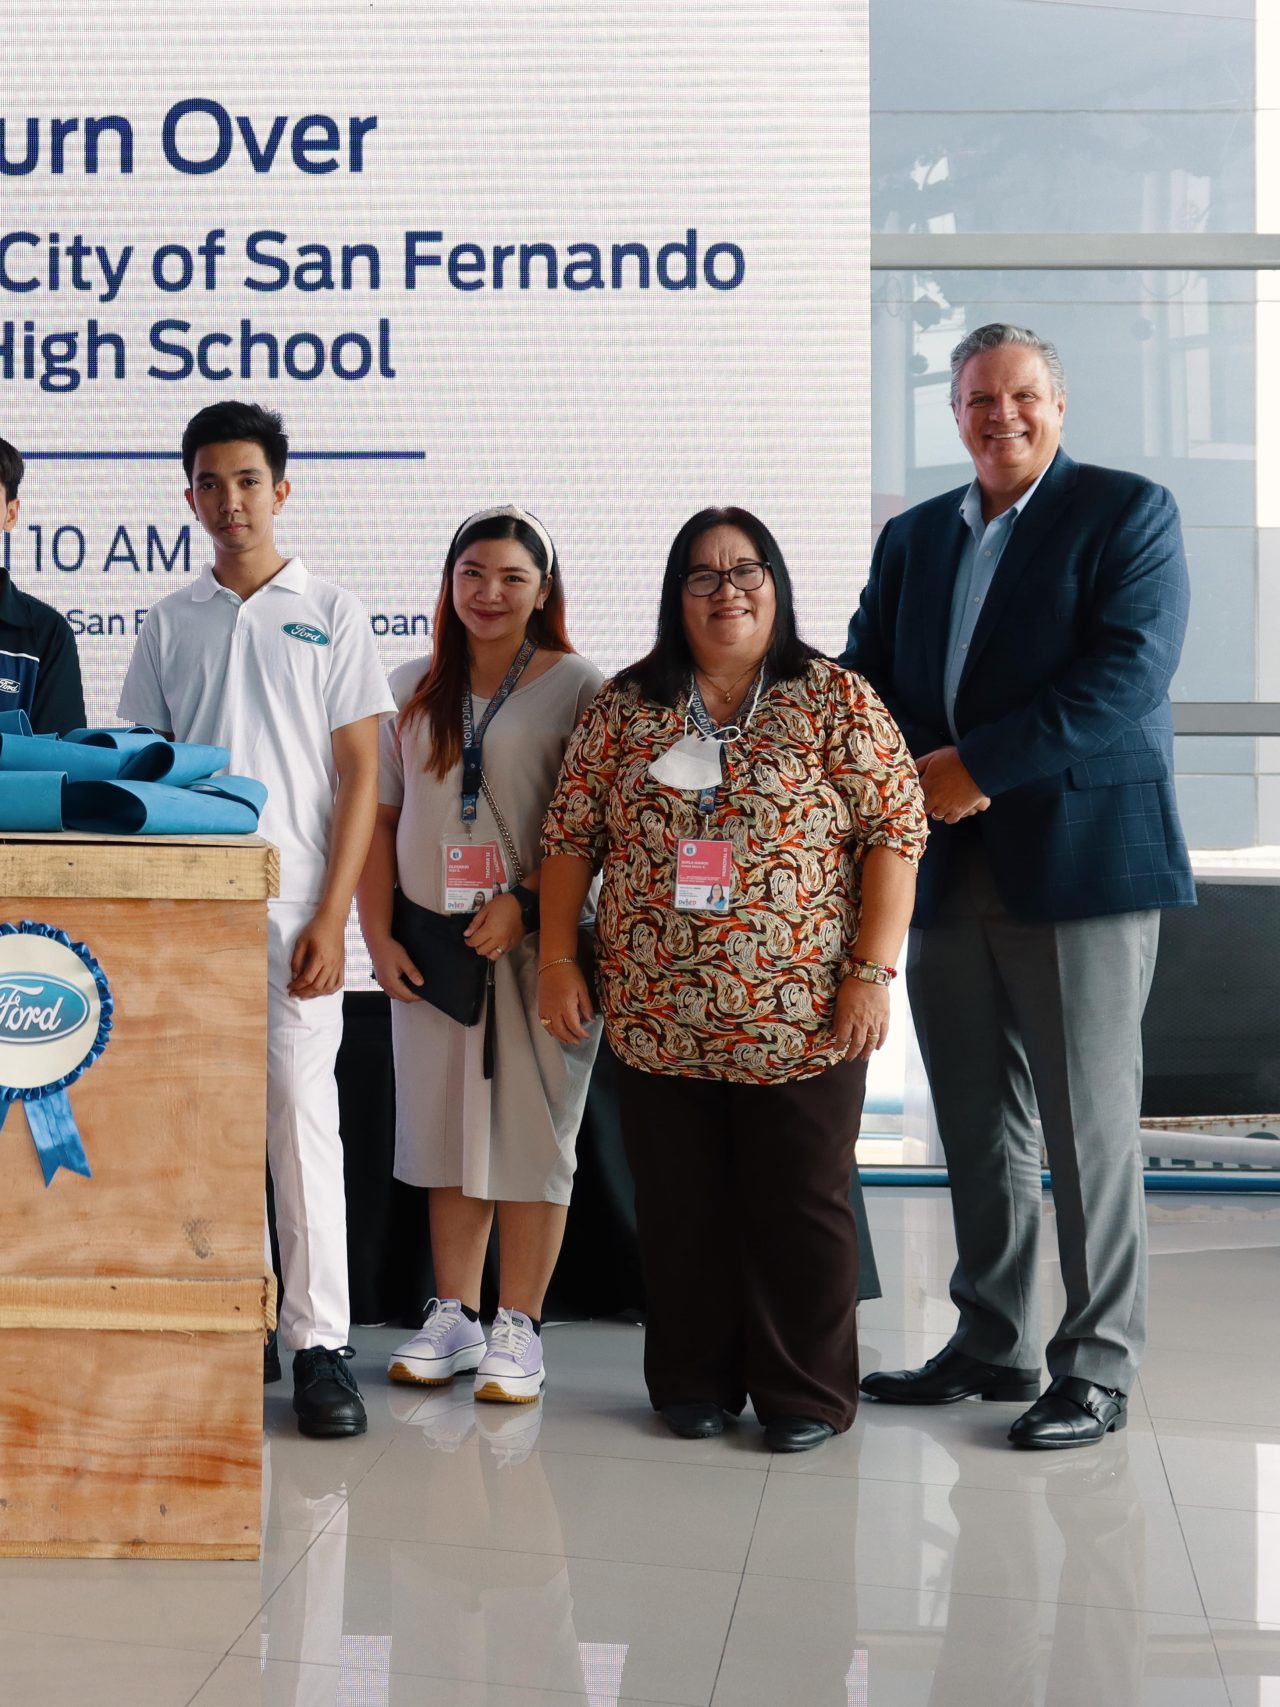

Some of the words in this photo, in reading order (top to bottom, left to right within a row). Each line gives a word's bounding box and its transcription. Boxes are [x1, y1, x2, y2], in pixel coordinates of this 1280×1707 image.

[163, 98, 377, 175] Over
[152, 228, 225, 293] of
[244, 230, 381, 292] San
[404, 228, 746, 292] Fernando
[147, 318, 396, 381] School
[28, 524, 86, 573] 10
[103, 525, 191, 573] AM
[66, 609, 126, 635] San
[290, 624, 321, 642] Ford
[690, 694, 713, 736] EDUCATIO
